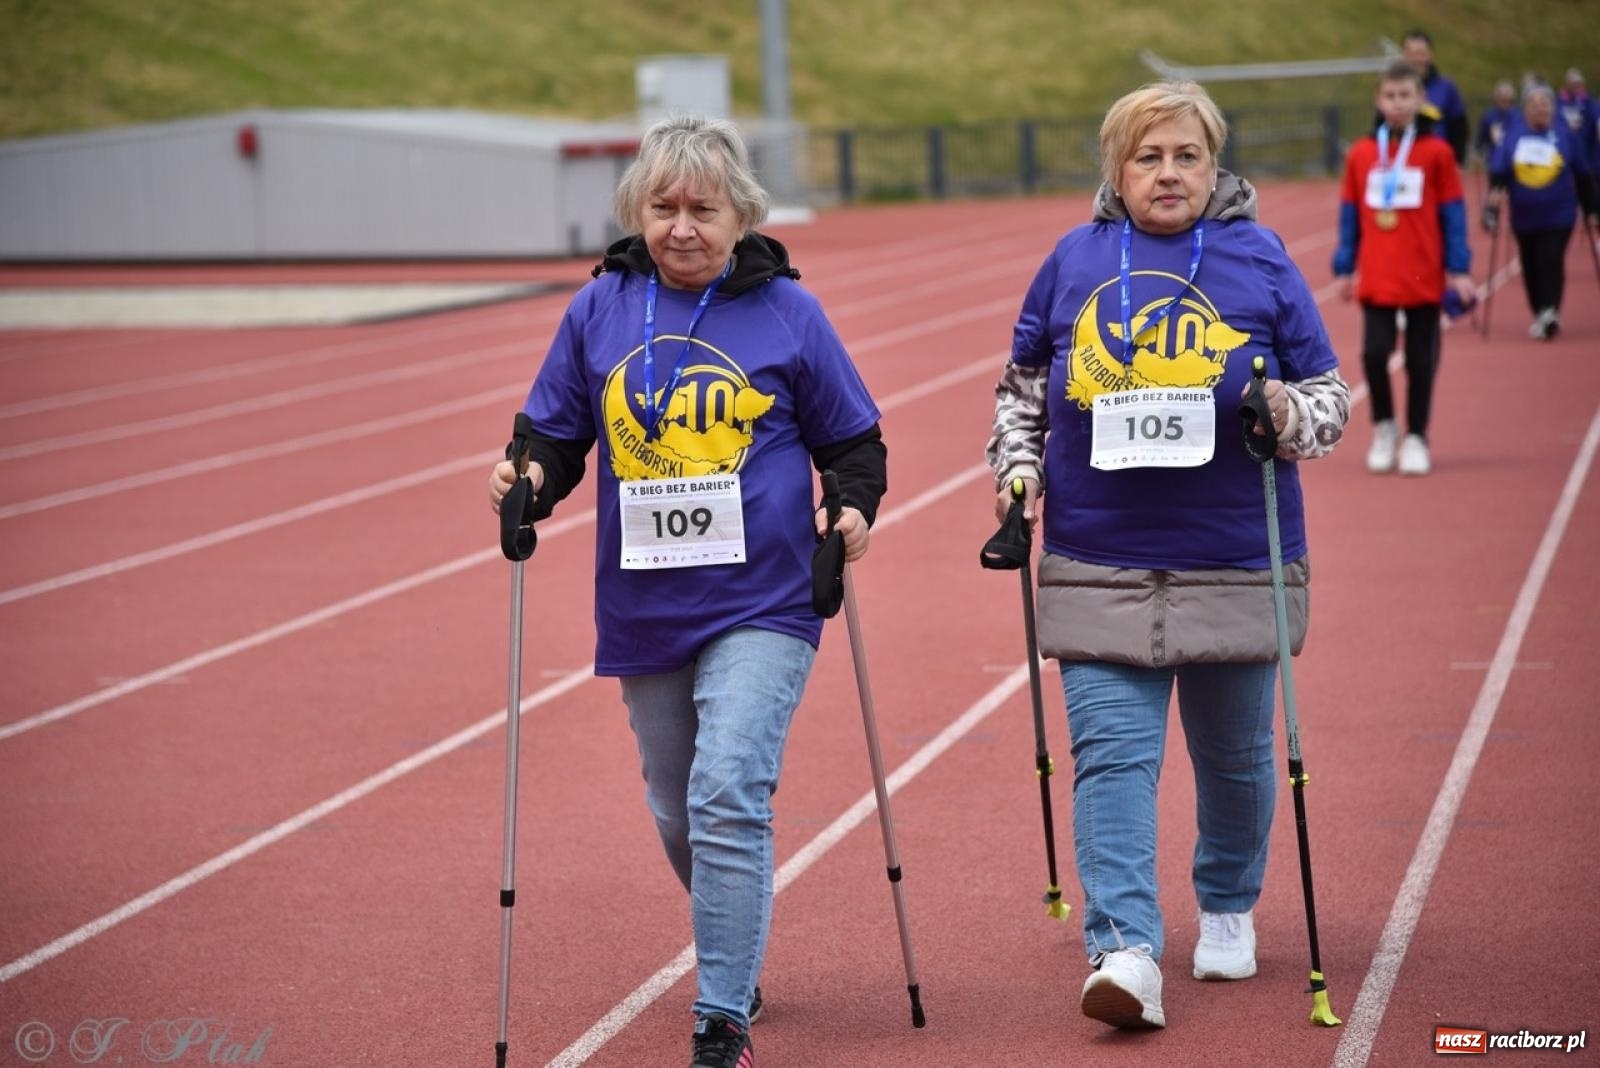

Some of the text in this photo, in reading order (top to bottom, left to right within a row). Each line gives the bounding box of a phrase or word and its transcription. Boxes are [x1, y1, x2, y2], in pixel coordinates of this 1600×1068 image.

[1114, 394, 1140, 406] BIEG
[1143, 392, 1164, 402] BEZ
[1166, 392, 1207, 402] BARIER
[1125, 414, 1185, 441] 105
[612, 417, 684, 478] RACIBORSKI
[639, 485, 664, 496] BIEG
[666, 483, 687, 494] BEZ
[690, 480, 731, 493] BARIER
[652, 507, 713, 539] 109
